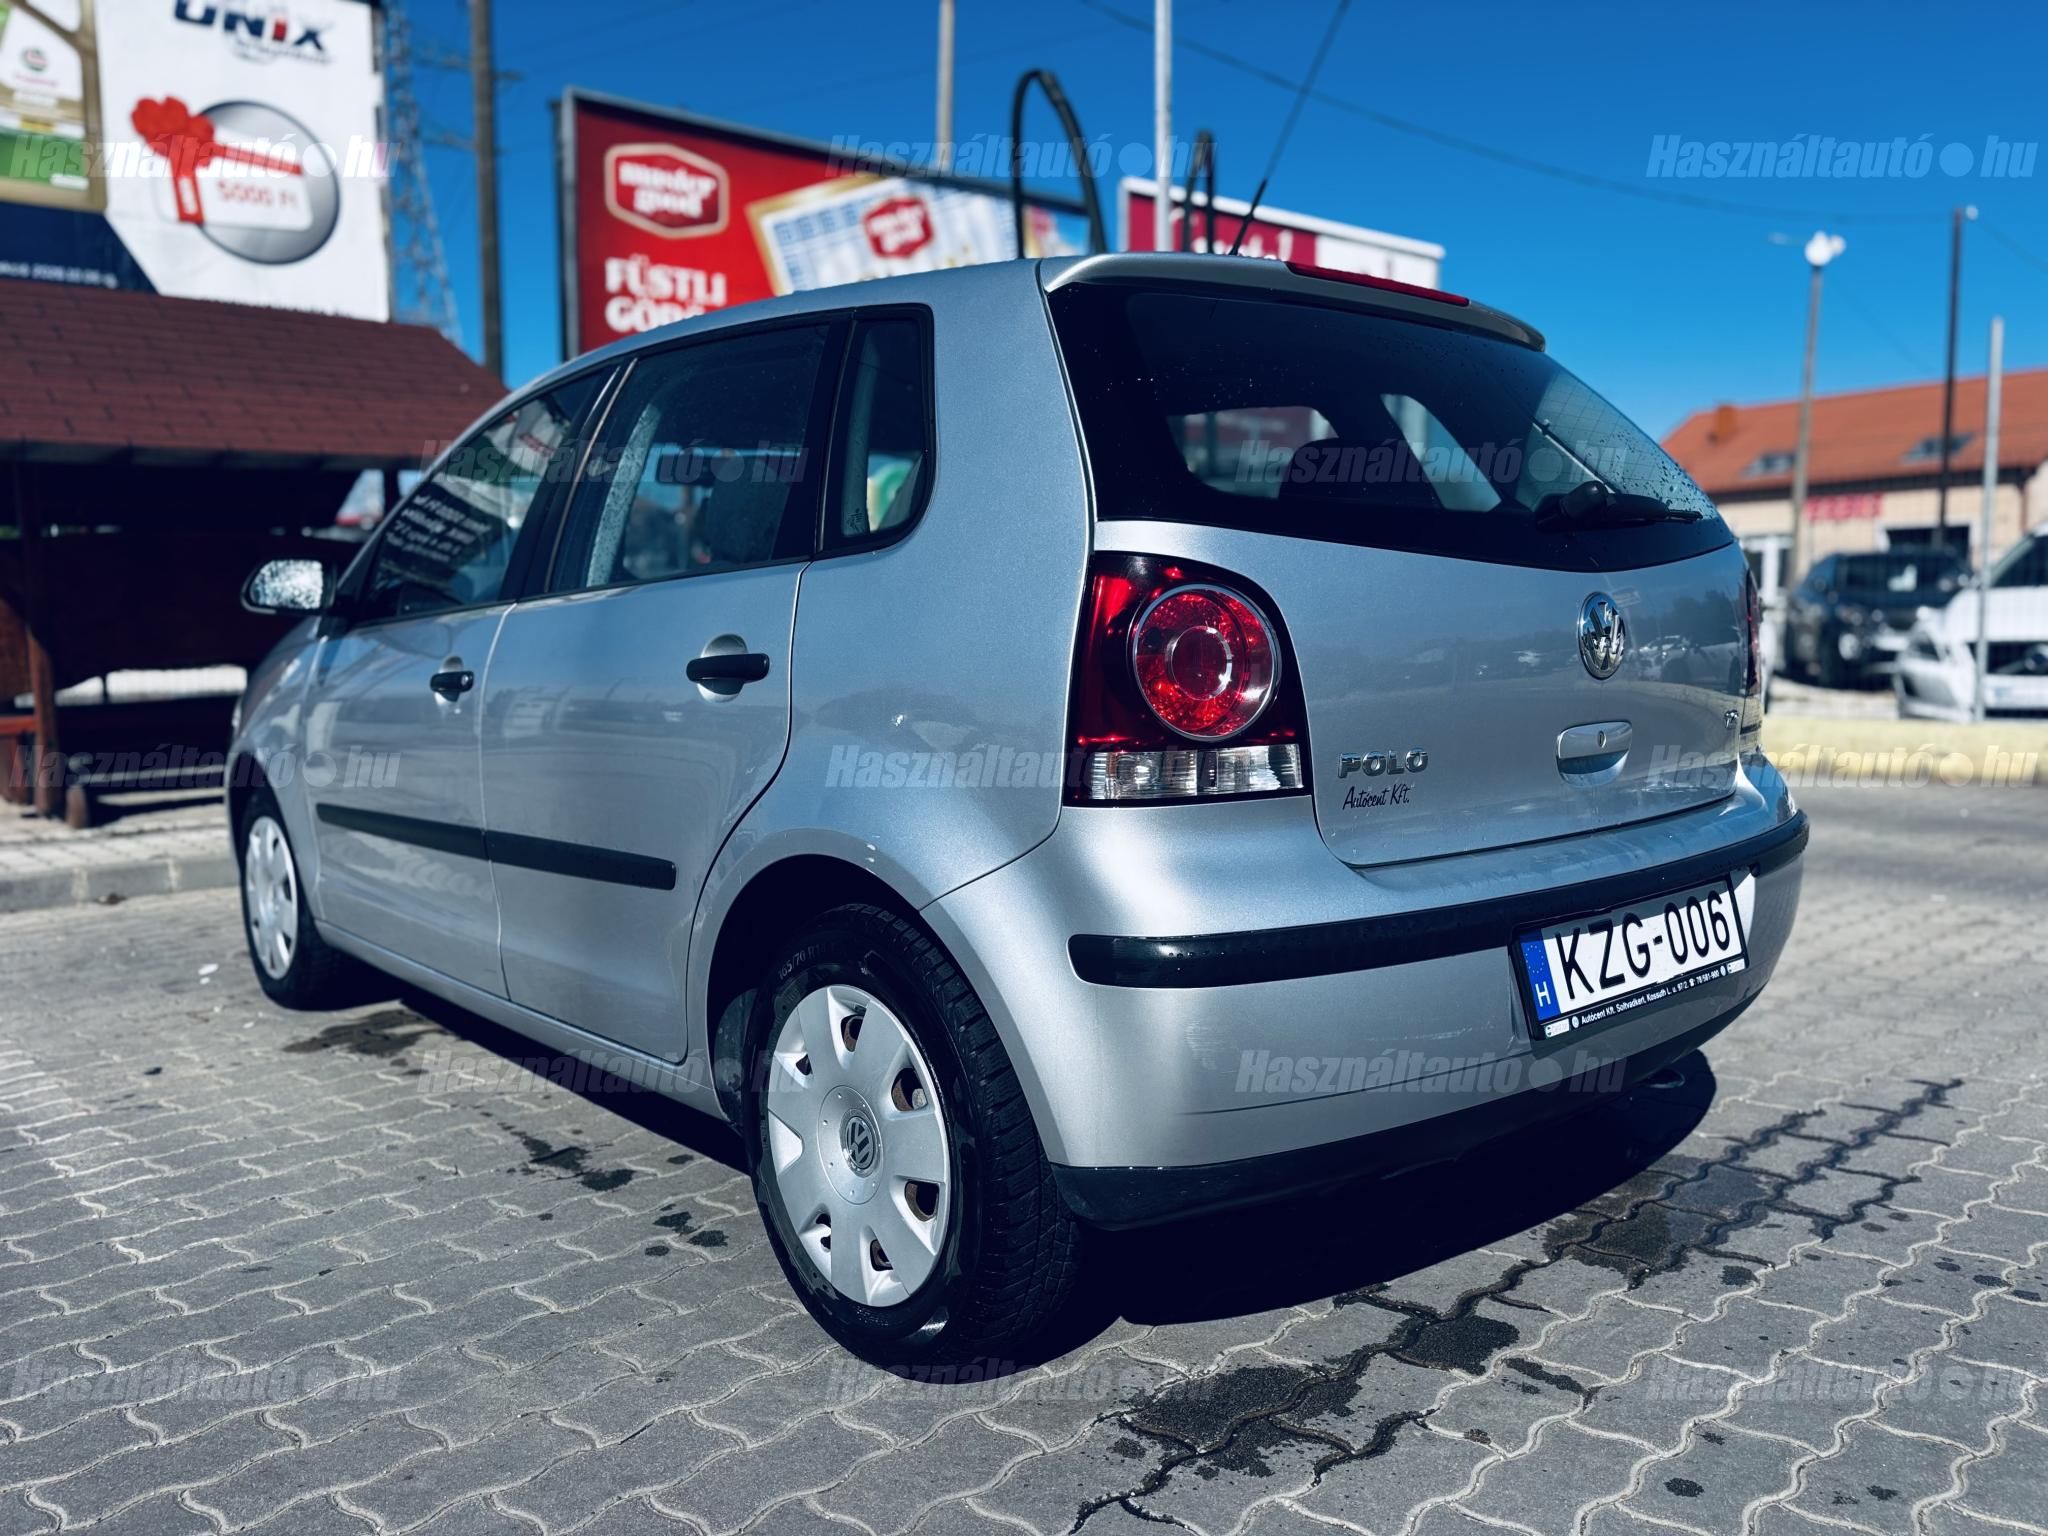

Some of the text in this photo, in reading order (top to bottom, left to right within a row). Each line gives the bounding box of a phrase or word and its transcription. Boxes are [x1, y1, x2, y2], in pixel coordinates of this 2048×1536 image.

[1337, 747, 1429, 778] POLO
[1555, 890, 1730, 1000] KZG-006
[1535, 981, 1551, 1008] H
